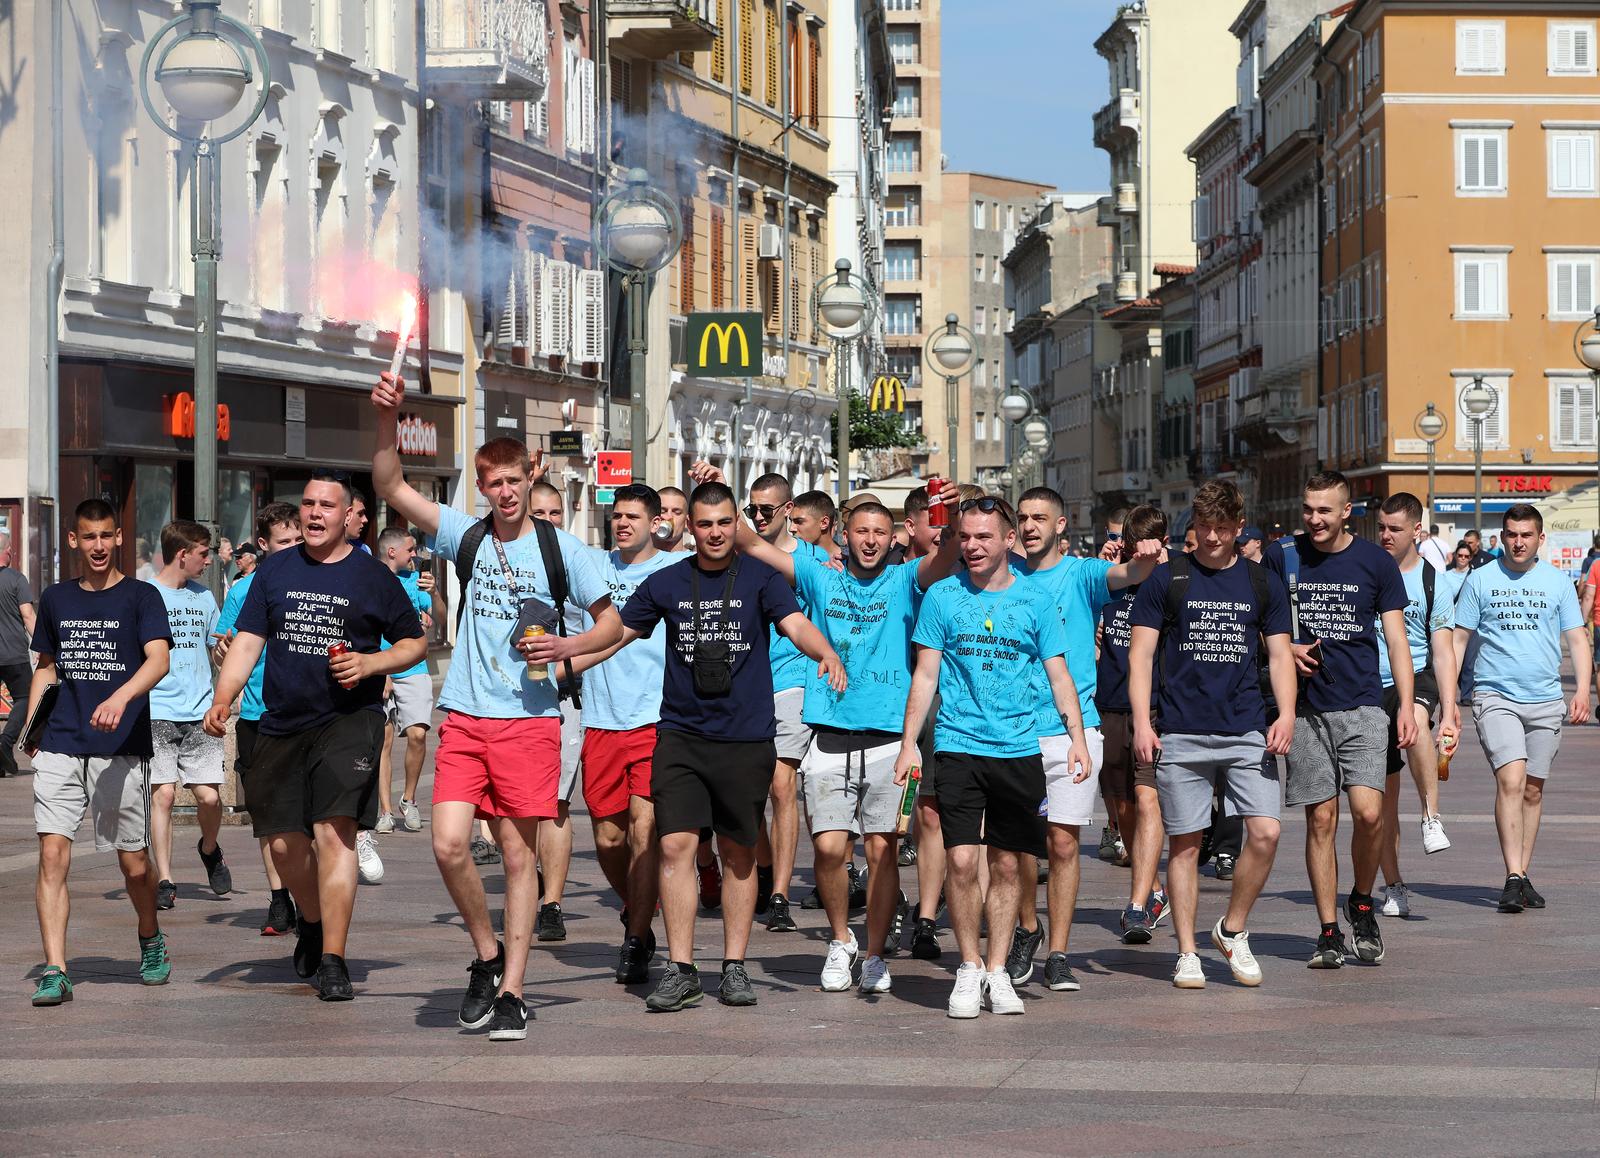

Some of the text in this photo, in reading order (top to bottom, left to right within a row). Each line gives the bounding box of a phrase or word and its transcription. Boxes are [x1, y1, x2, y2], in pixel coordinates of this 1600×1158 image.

[401, 415, 438, 456] ciciban
[610, 467, 632, 477] Lutri
[1498, 476, 1552, 492] TISAK
[1439, 504, 1462, 512] TISAK
[1298, 582, 1360, 593] PROFESORE SMO
[1491, 588, 1546, 598] Boje bira
[286, 591, 350, 607] PROFESORE SMO
[474, 591, 502, 606] delo
[1490, 599, 1548, 609] vruke leh
[678, 600, 743, 610] PROESORE MO
[1187, 601, 1251, 612] PROFESORE SMO
[1300, 601, 1327, 612] MRŠIĆA
[167, 607, 204, 618] oje bira
[285, 610, 313, 622] MRŠIĆA
[854, 613, 861, 622] SE
[1298, 612, 1356, 623] CNC SMO PROŠLI
[1403, 610, 1418, 619] eh
[1497, 611, 1522, 620] delo
[60, 620, 120, 629] PROFESORE SMO
[170, 618, 205, 628] uke leh
[1189, 620, 1217, 630] MRŠIĆA
[1332, 623, 1364, 633] RAZREDA
[1500, 622, 1539, 631] struke
[172, 630, 186, 638] elo
[284, 621, 344, 637] CNC SMO PROŠLI
[1105, 626, 1115, 635] DO
[1116, 628, 1132, 639] TREĆ
[280, 632, 289, 641] DO
[289, 632, 317, 644] TREĆEG
[317, 636, 353, 649] RAZDA
[678, 633, 695, 641] CNC
[956, 633, 1021, 649] DRVO BAKAR OLOVO
[1188, 632, 1203, 641] CNC
[1203, 632, 1220, 641] SMO
[1316, 630, 1330, 639] GUZ
[1330, 631, 1351, 641] DOŠLI
[60, 638, 85, 649] MRŠIĆA
[1112, 638, 1123, 647] NA
[1182, 642, 1194, 651] DO
[1194, 640, 1222, 652] TREĆEG
[60, 650, 117, 660] CNC SMO PROŠLI
[288, 643, 330, 657] NA GUZ DOŠ
[975, 648, 983, 656] SI
[983, 649, 993, 658] SE
[1201, 653, 1218, 662] GUZ
[1219, 652, 1242, 664] DOŠLI
[64, 659, 91, 669] TREĆEG
[91, 662, 126, 671] RAZREDA
[981, 660, 993, 672] BIŠ
[72, 671, 88, 680] GUZ
[88, 671, 111, 681] DOŠLI
